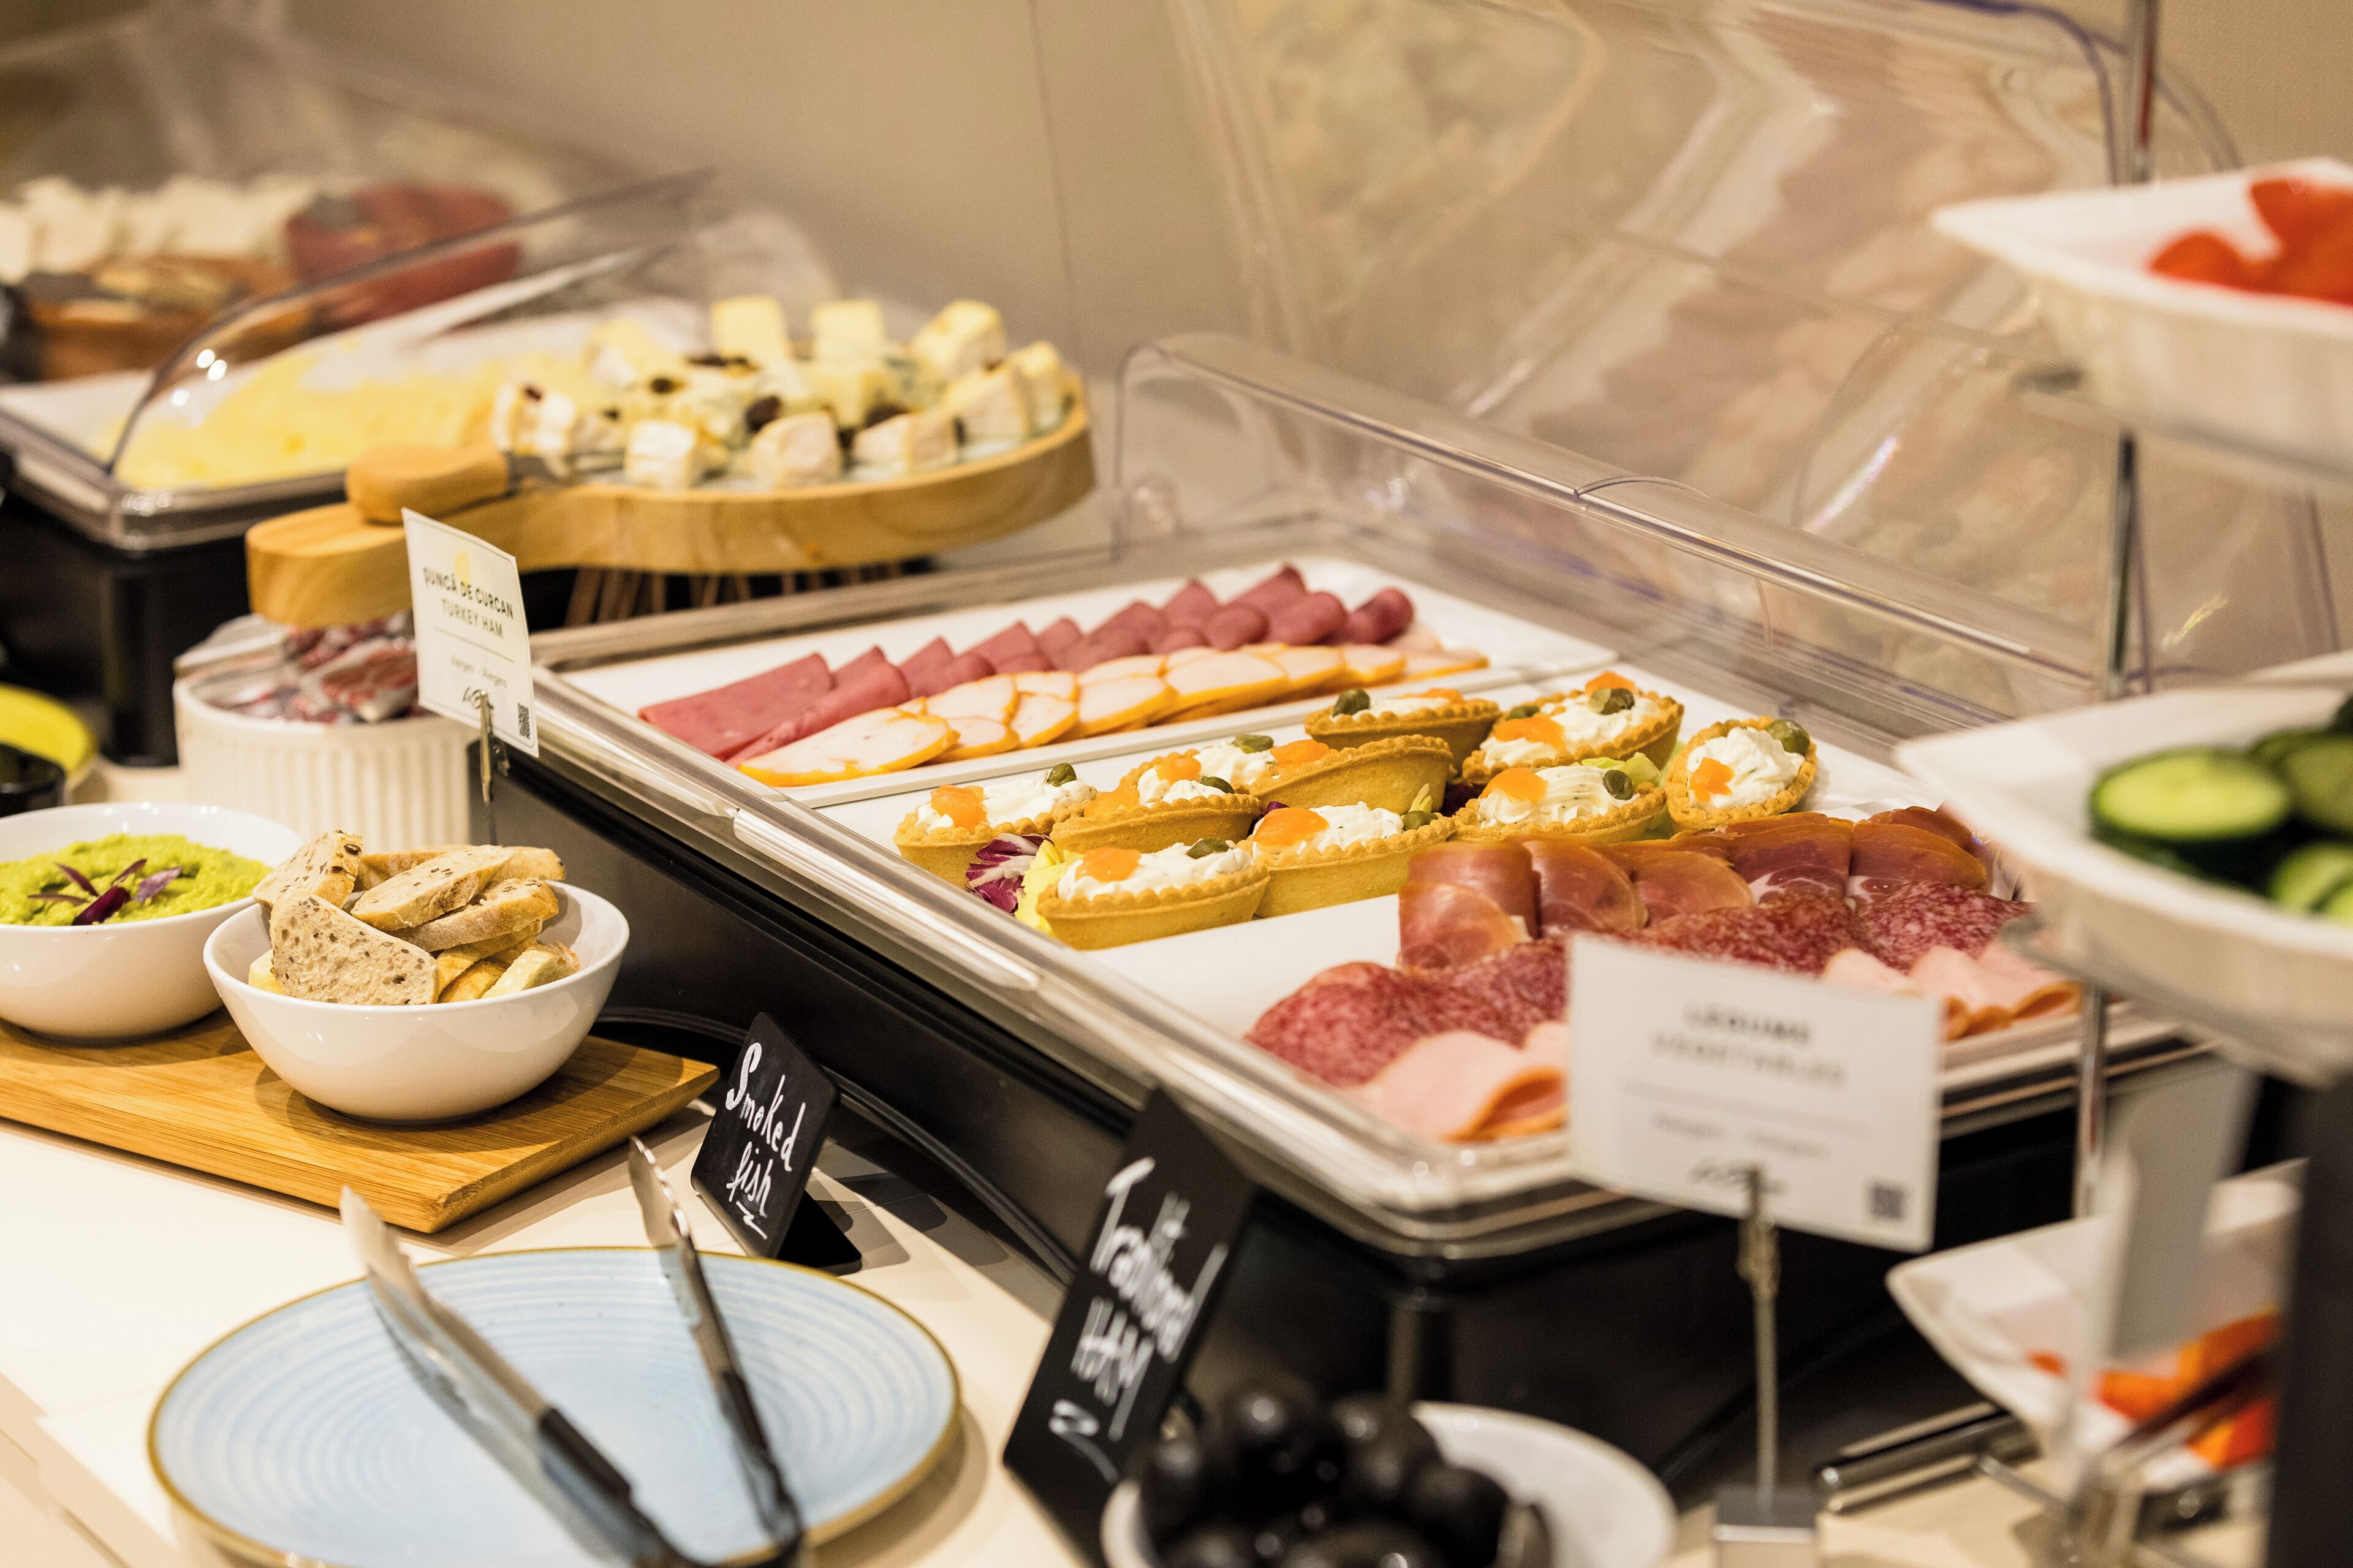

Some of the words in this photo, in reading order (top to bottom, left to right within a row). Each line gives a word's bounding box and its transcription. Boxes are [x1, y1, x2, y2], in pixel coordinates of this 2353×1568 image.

[441, 597, 478, 626] TURKEY
[482, 615, 502, 638] HAM
[460, 580, 473, 600] DE
[476, 588, 513, 619] CURCAN
[726, 1043, 806, 1172] Smoked
[726, 1142, 773, 1218] fish
